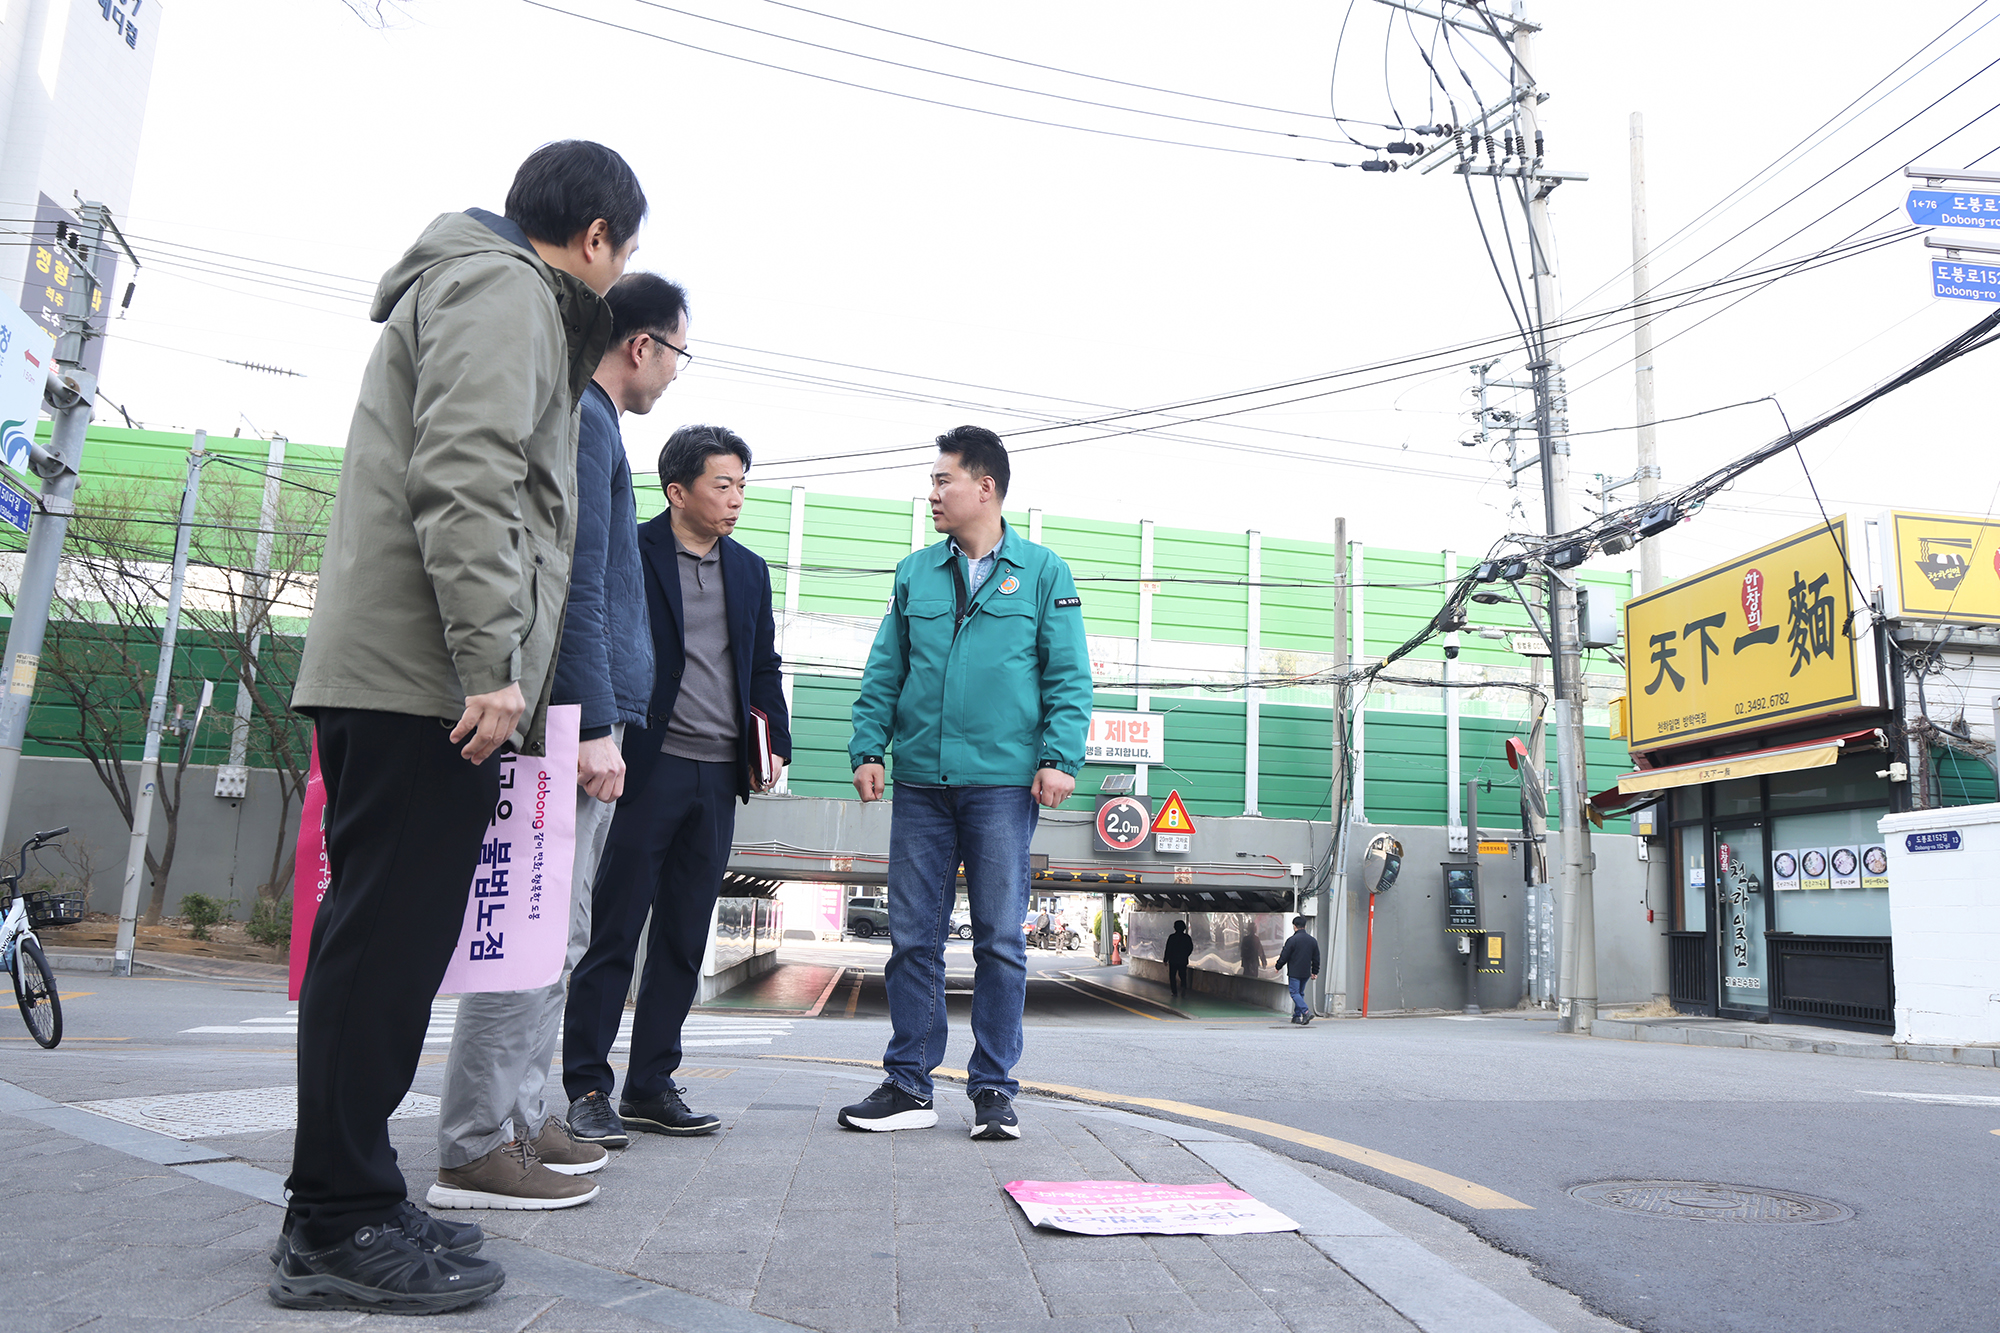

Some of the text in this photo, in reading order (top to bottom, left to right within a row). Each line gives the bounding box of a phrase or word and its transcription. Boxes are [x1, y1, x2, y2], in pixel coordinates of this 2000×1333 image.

[1952, 196, 2000, 213] 도봉로
[1937, 284, 1996, 300] Dobong-ro
[1744, 571, 1762, 627] 한창희
[1644, 570, 1835, 696] 天下一麵
[1734, 692, 1790, 715] 02.3492.6782
[1104, 719, 1150, 743] 제한
[1657, 711, 1707, 734] 천하일면 방학역점
[1105, 746, 1151, 759] 금지합니다.
[532, 770, 551, 829] dobong
[1107, 813, 1140, 834] 2.0m
[533, 832, 545, 850] 같이
[470, 837, 512, 961] 불법노점
[529, 873, 543, 903] 행복한
[528, 905, 541, 921] 도봉
